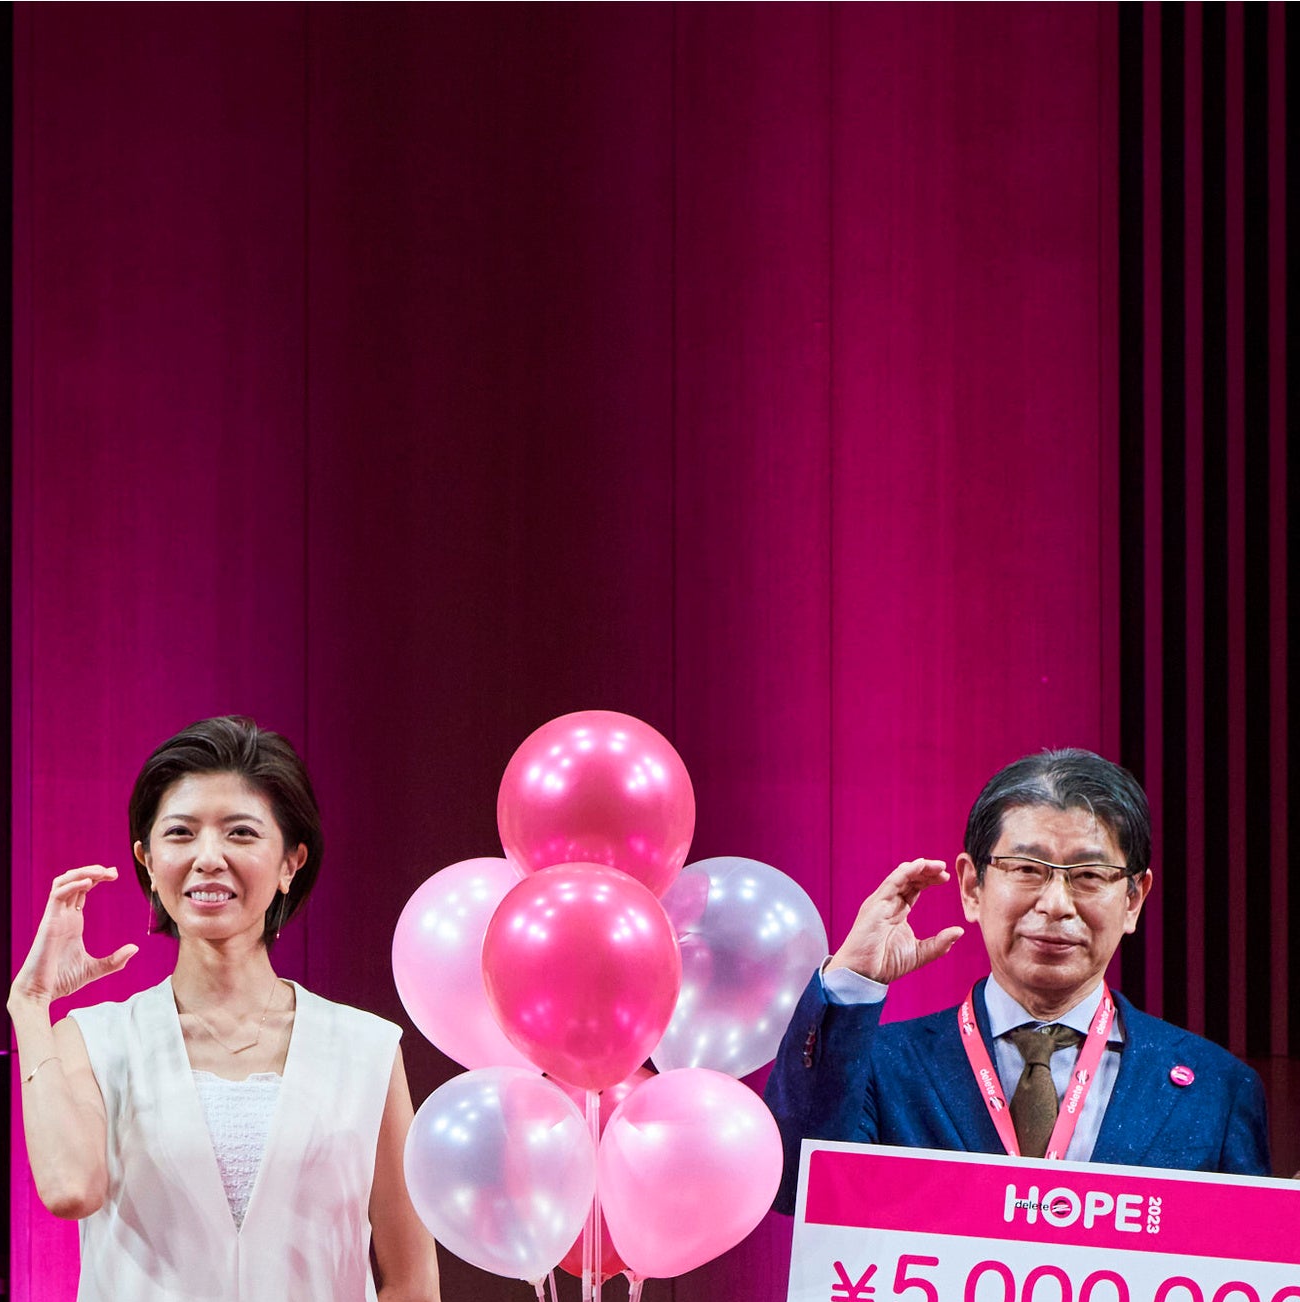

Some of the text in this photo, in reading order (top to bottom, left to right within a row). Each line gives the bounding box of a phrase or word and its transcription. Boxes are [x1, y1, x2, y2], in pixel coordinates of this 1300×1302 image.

[979, 1068, 997, 1096] delete
[1067, 1083, 1085, 1115] delete
[1003, 1183, 1163, 1235] HOPE 2023
[1014, 1199, 1050, 1212] delete
